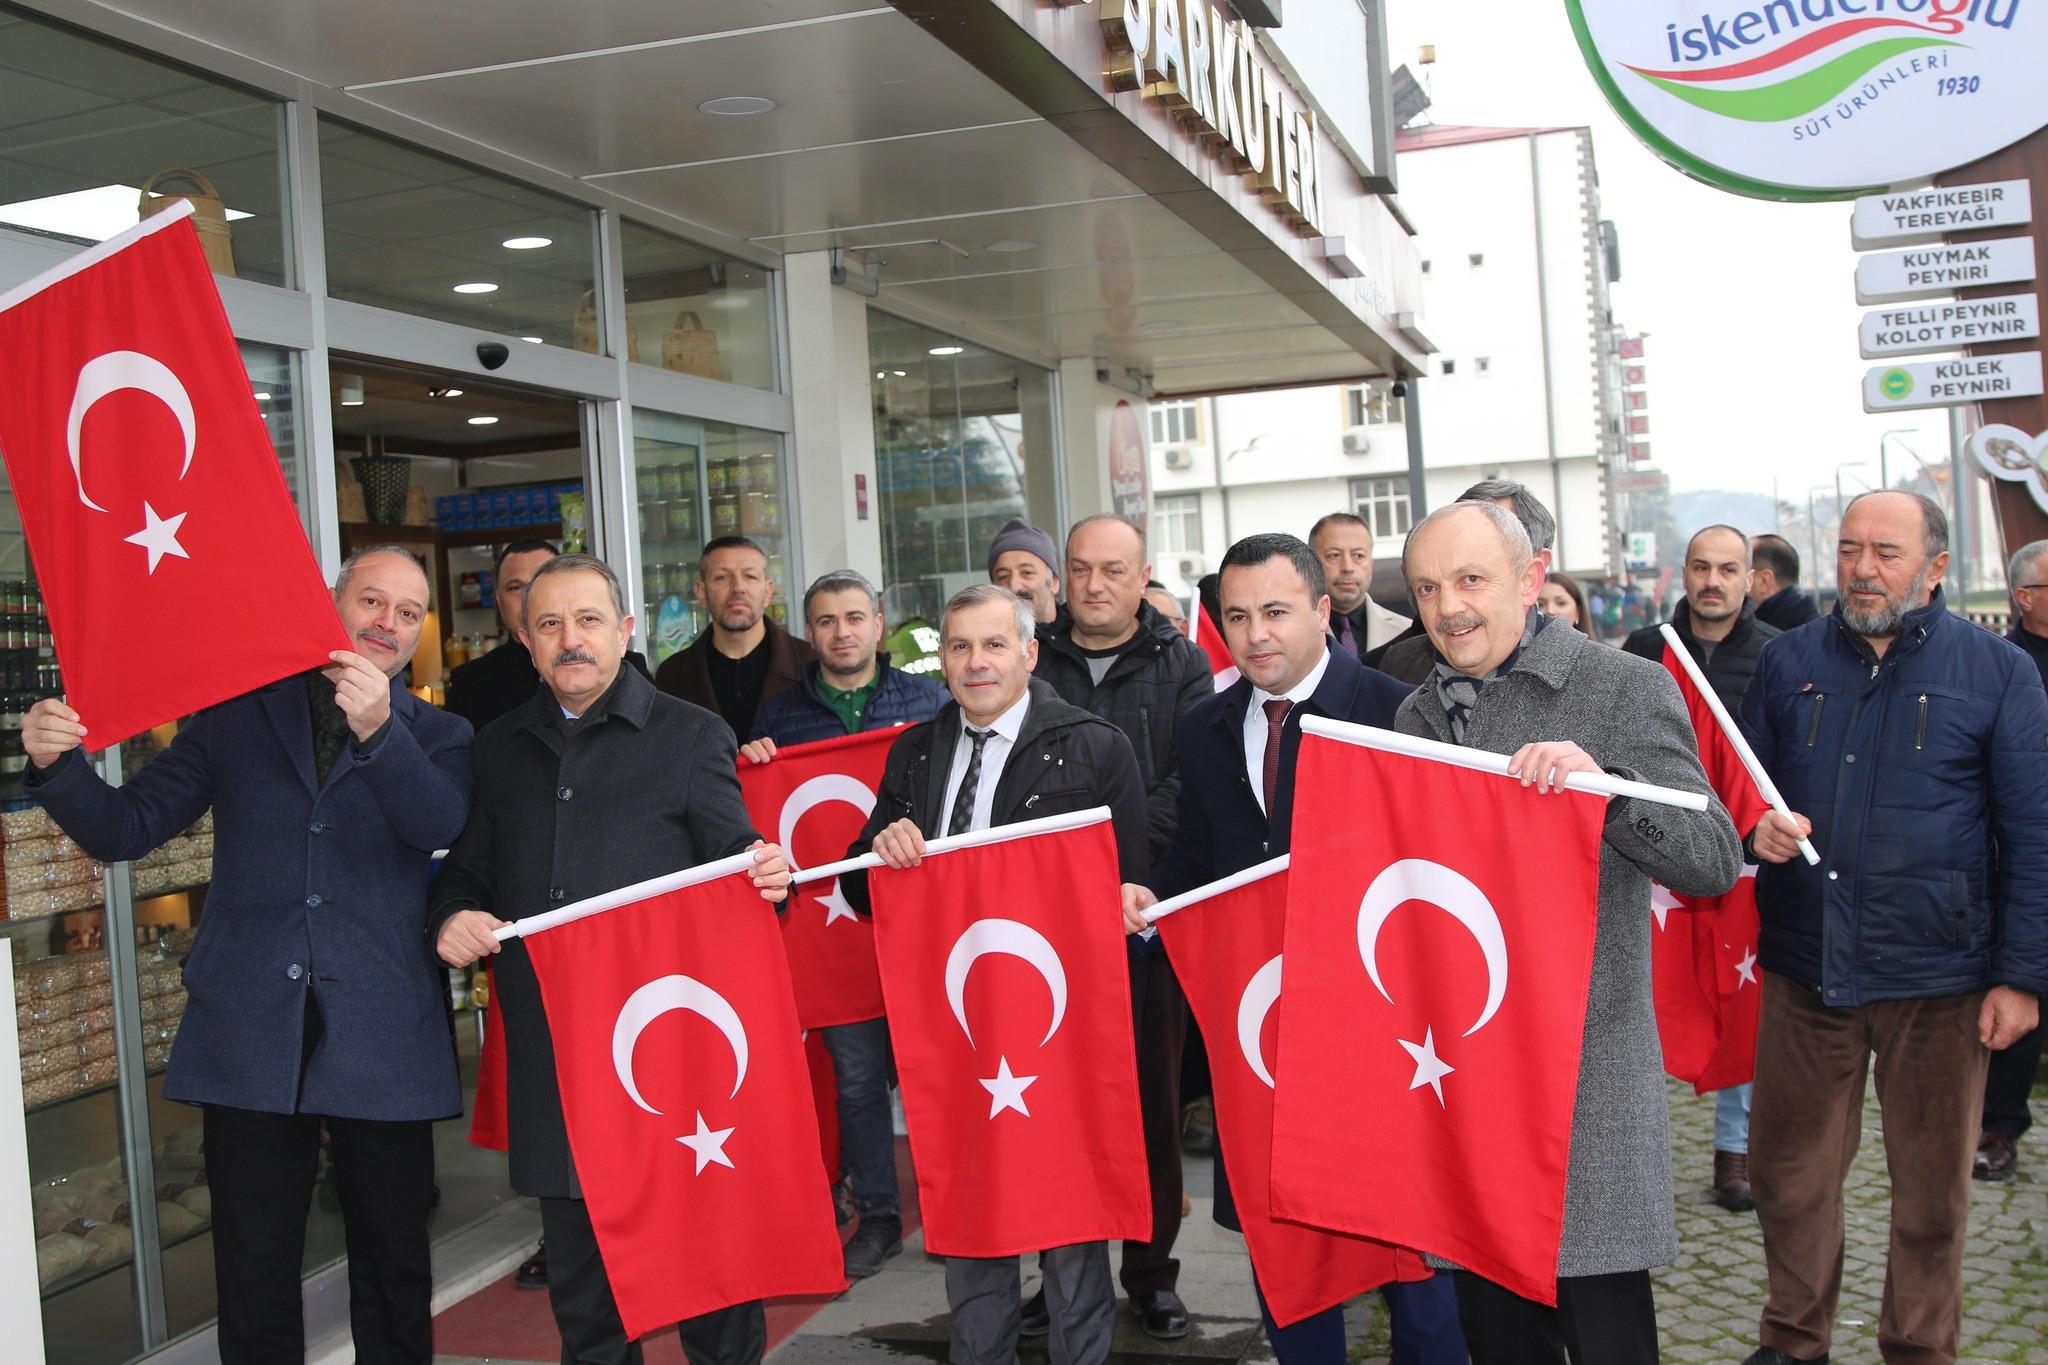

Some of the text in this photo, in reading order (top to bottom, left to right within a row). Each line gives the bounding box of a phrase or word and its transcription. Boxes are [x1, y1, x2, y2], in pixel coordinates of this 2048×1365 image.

[1793, 50, 1949, 141] SÜT ÜRÜNLERİ
[1936, 75, 1980, 96] 1930
[1895, 205, 1994, 229] TEREYAĞI
[1903, 247, 1991, 268] KUYMAK
[1876, 327, 1944, 346] KOLOT
[1936, 360, 2003, 379] KÜLEK
